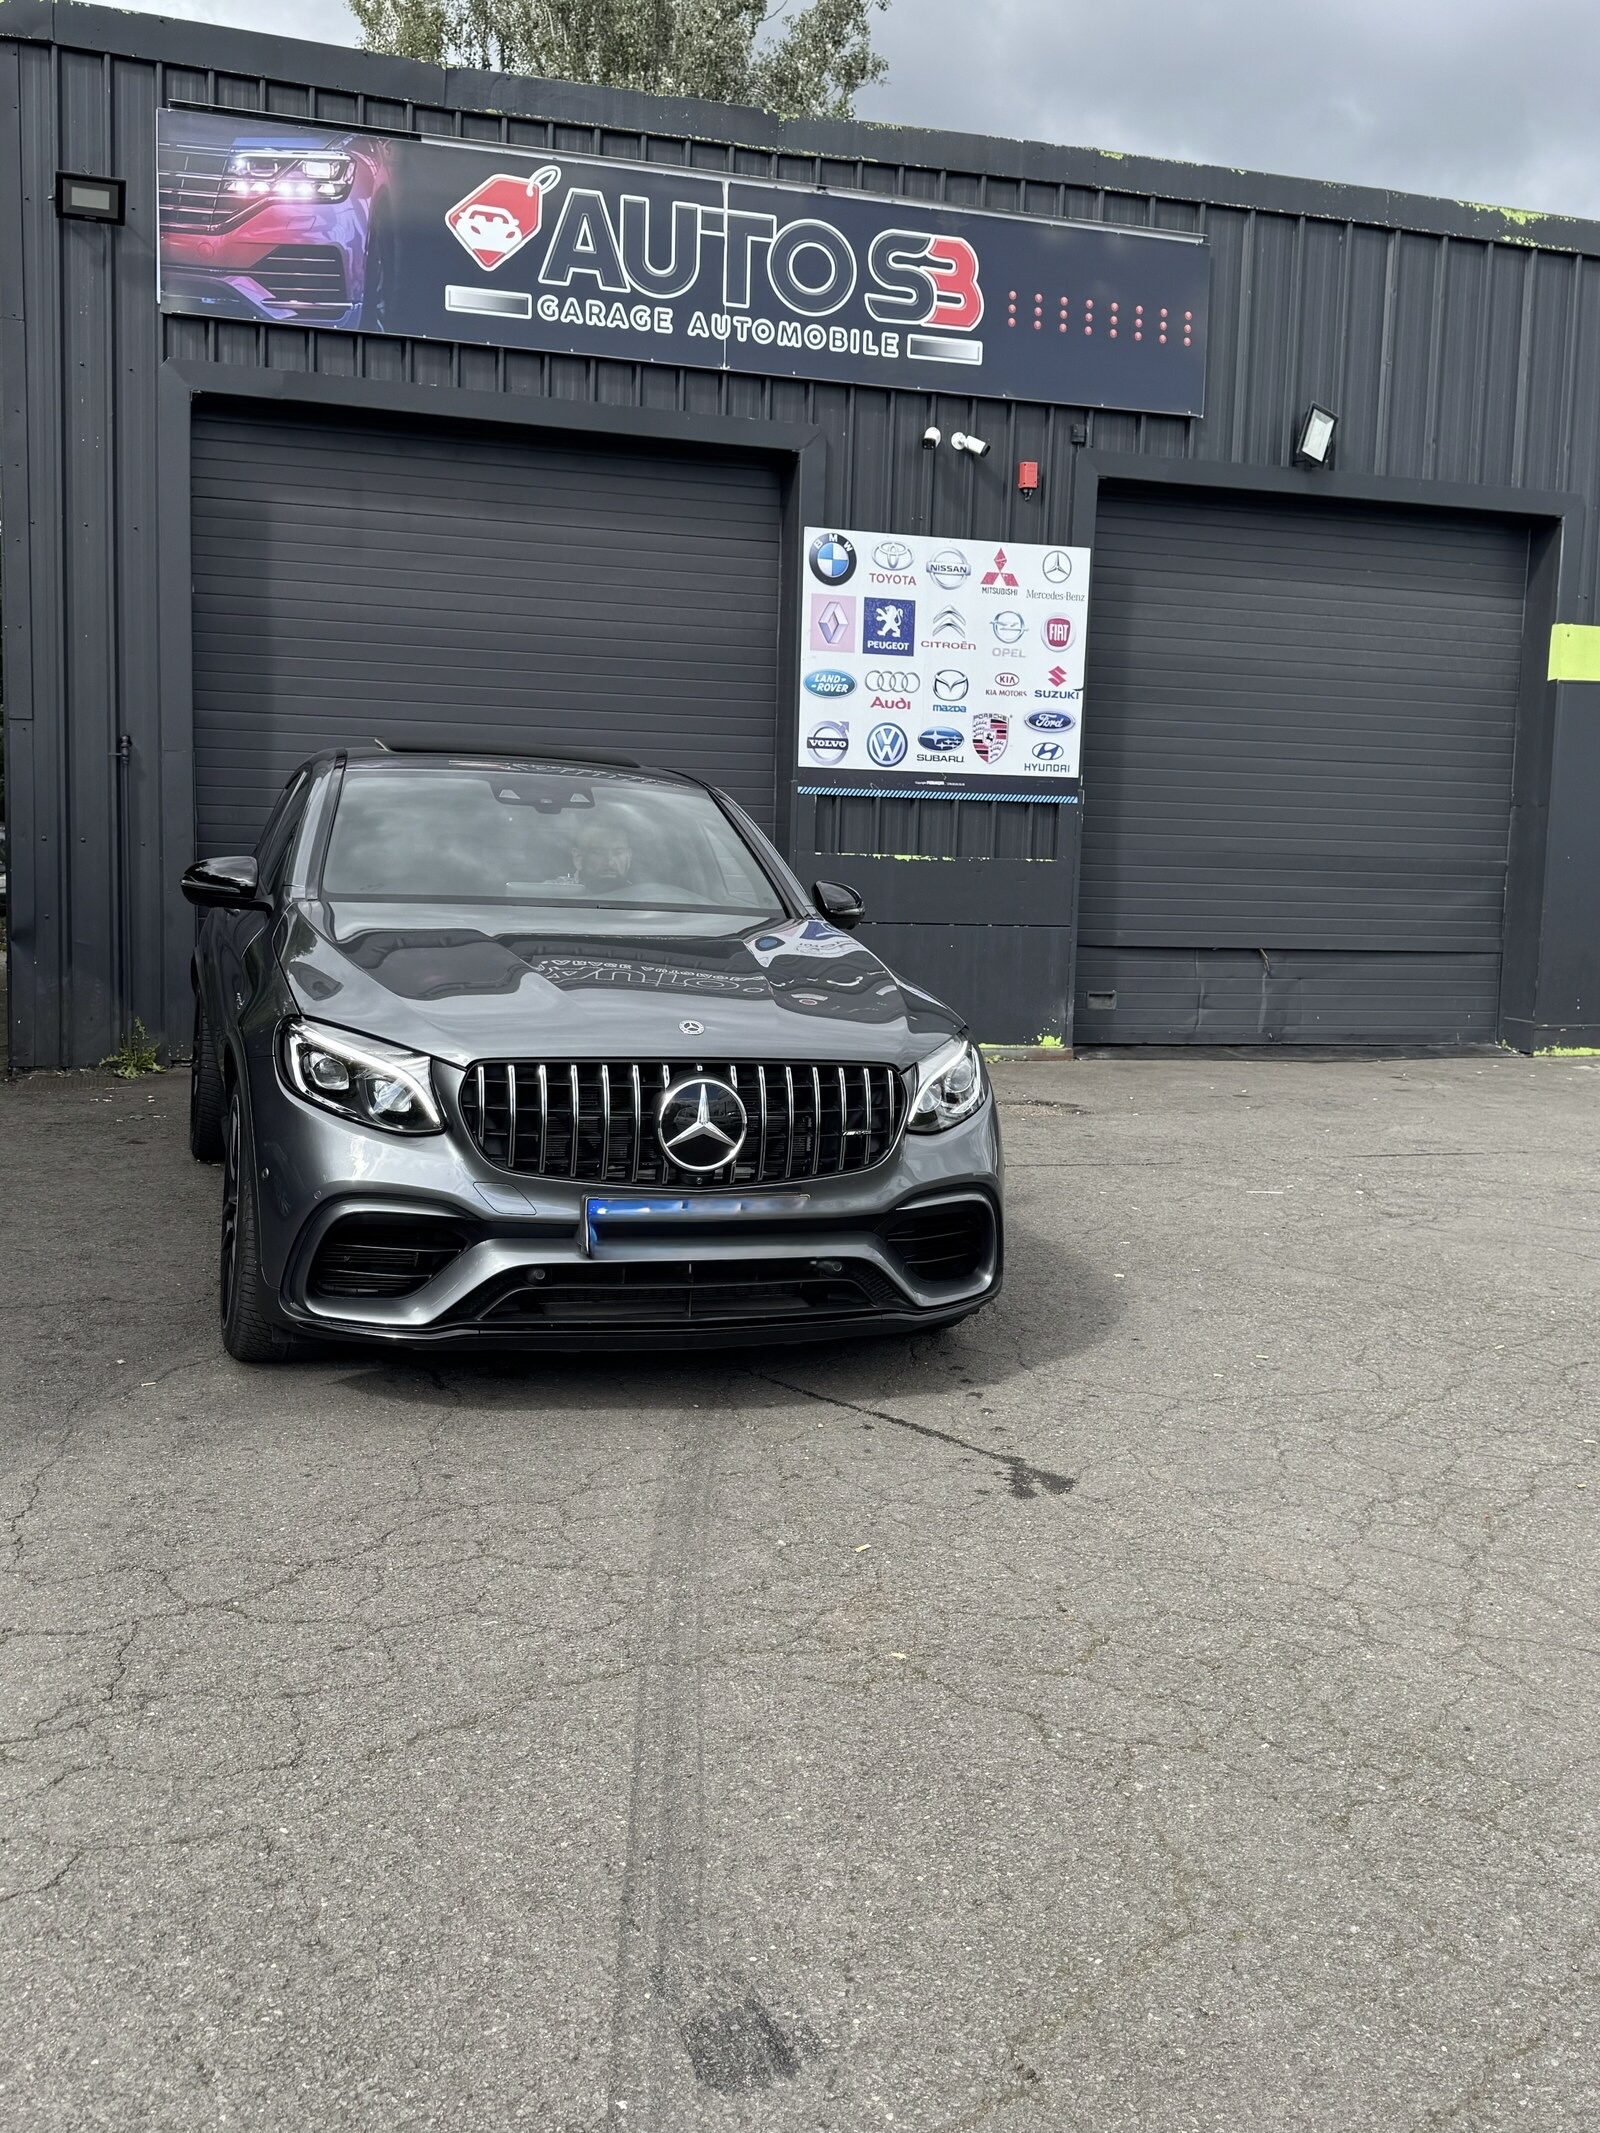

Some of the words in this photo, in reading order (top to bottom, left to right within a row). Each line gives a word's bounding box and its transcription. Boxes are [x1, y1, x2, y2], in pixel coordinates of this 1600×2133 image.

[537, 294, 673, 334] GARAGE
[687, 311, 899, 358] AUTOMOBILE
[814, 533, 854, 552] BMW
[930, 563, 967, 574] NISSAN
[869, 572, 917, 586] TOYOTA
[981, 586, 1018, 596] MITSUBISHI
[1026, 588, 1085, 602] Mercedes-Benz
[1049, 626, 1068, 642] FIAT
[867, 640, 910, 650] PEUGEOT
[992, 647, 1026, 658] OPEL
[1034, 689, 1079, 700] SUZUKI
[870, 696, 911, 710] Audi
[1035, 713, 1064, 728] Ford
[809, 739, 846, 749] VOLVO
[916, 753, 964, 763] SUBARU
[1024, 763, 1070, 773] HYUNDAI
